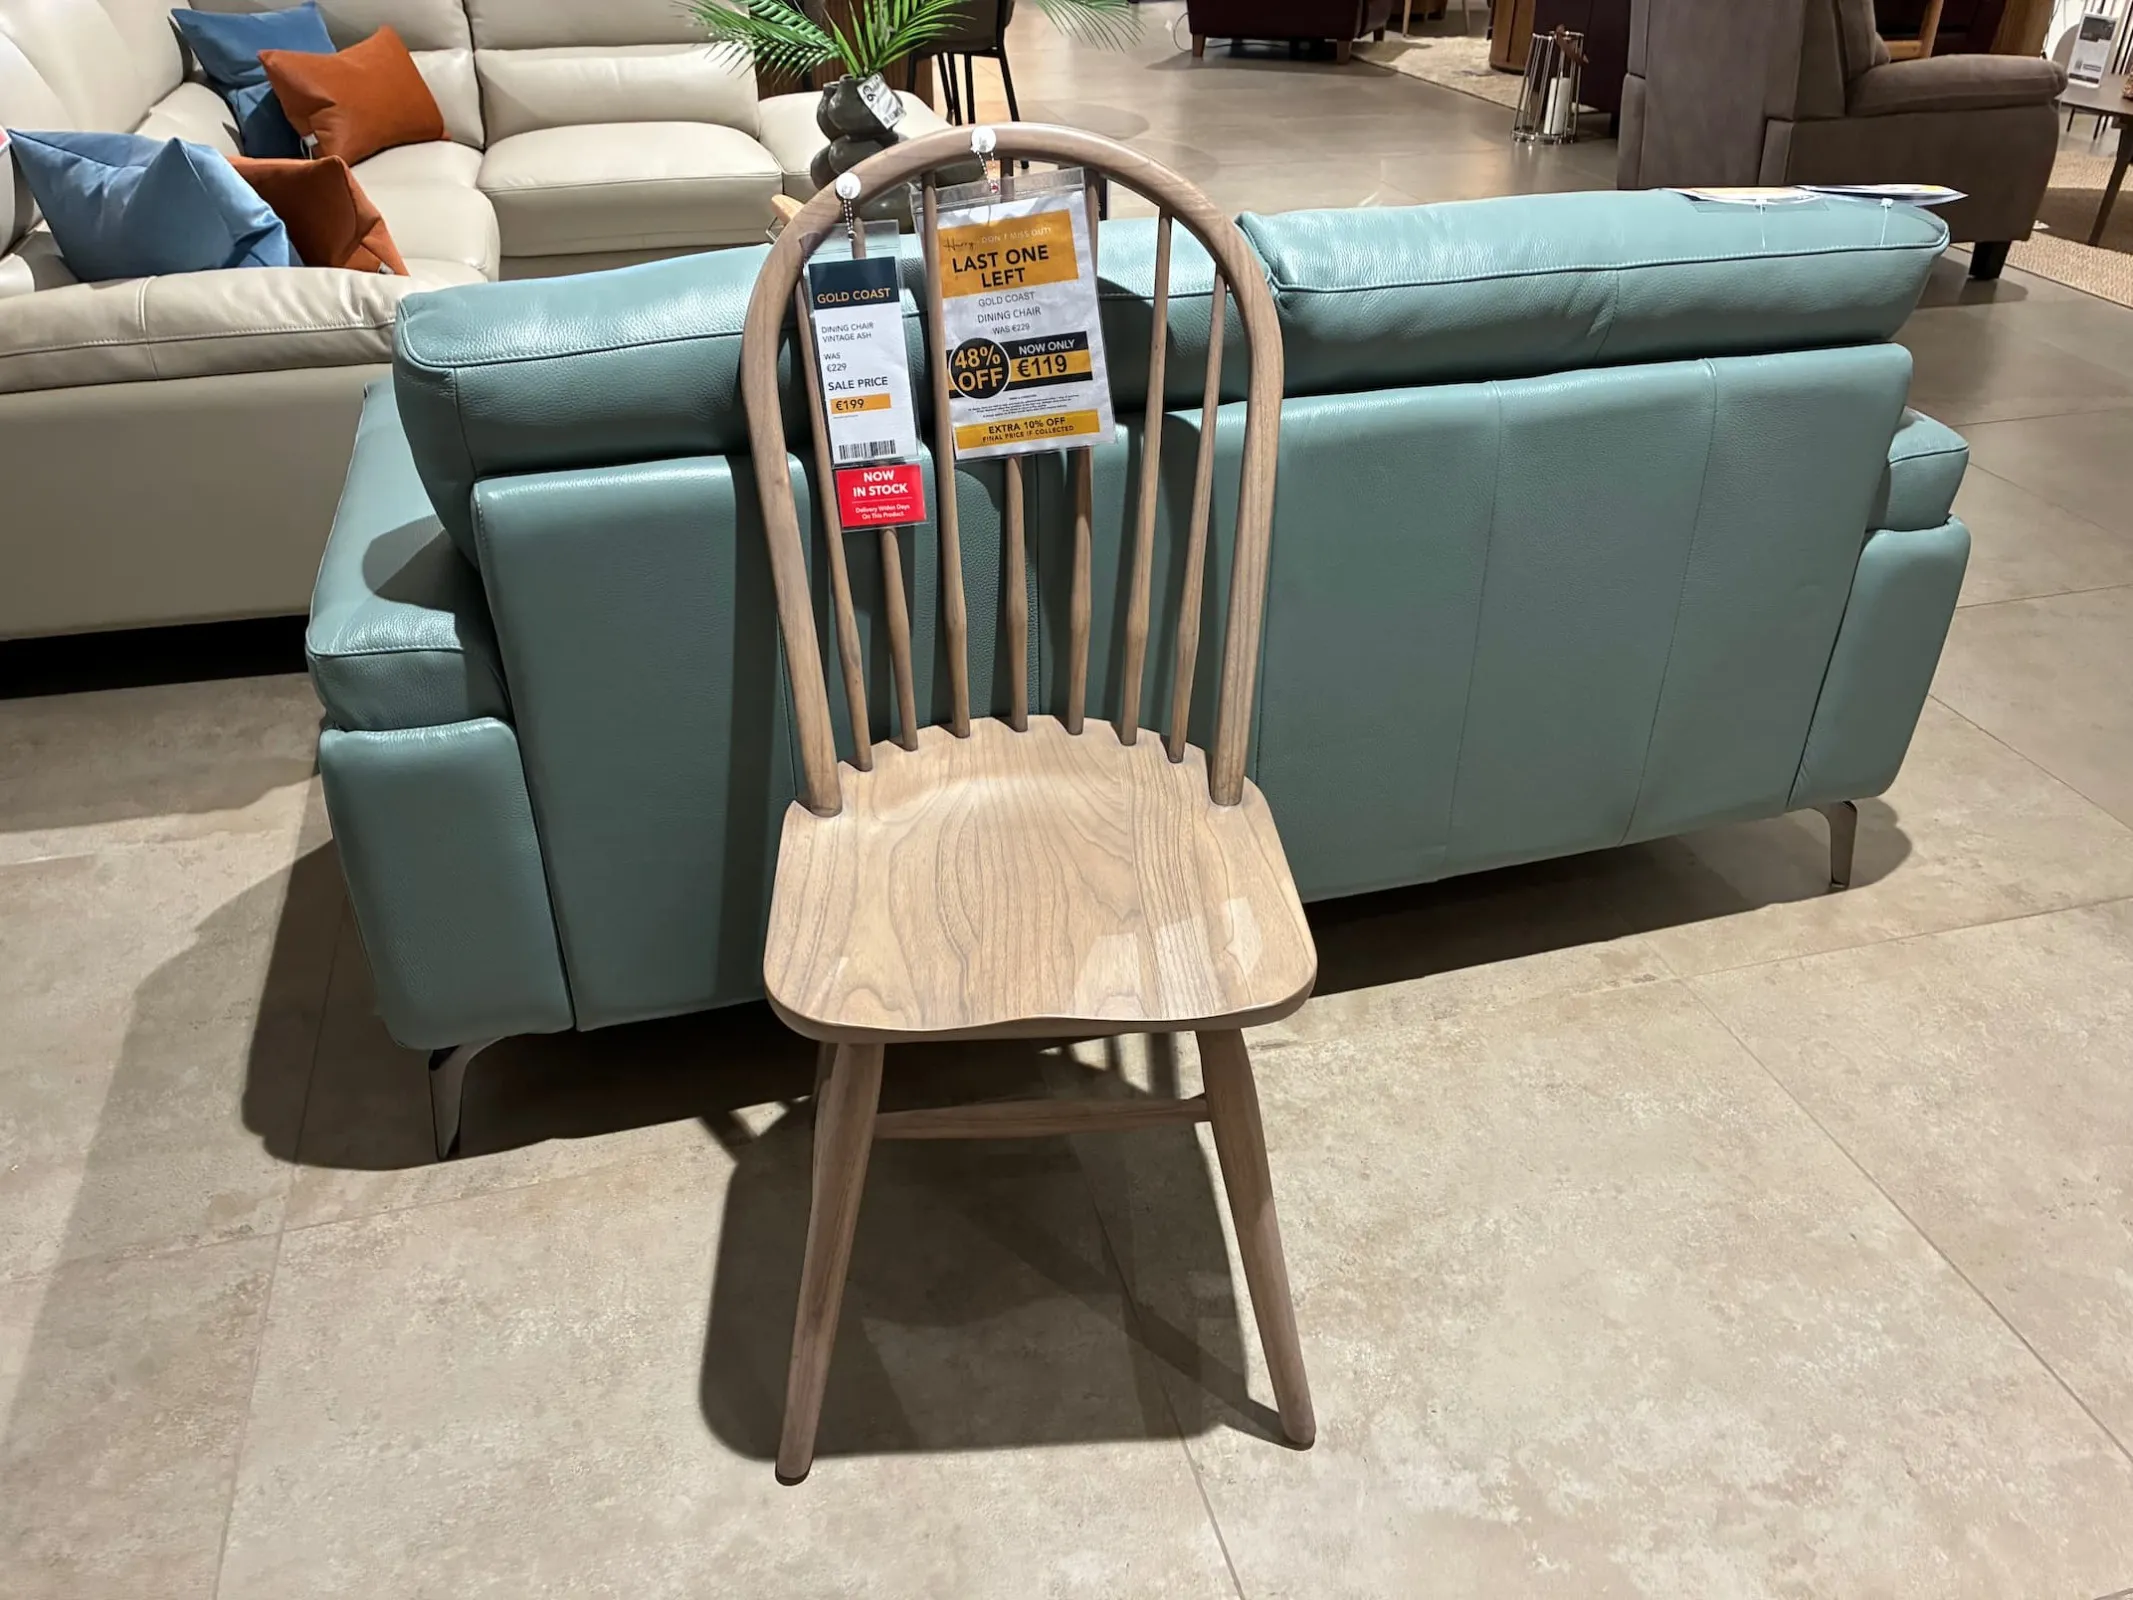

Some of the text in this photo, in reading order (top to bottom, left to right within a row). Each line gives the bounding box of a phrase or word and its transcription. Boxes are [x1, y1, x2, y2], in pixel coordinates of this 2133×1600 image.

[952, 244, 1049, 273] LAST ONE
[981, 267, 1025, 288] LEFT
[817, 287, 891, 304] GOLD COAST
[978, 291, 1035, 308] GOLD COAST
[977, 306, 1041, 324] DINING CHAIR
[821, 321, 874, 334] DINING CHAIR
[992, 322, 1030, 335] WAS €229
[822, 332, 872, 343] VINTAGE ASH
[1018, 339, 1075, 355] NOW ONLY
[824, 352, 841, 361] WAS
[955, 345, 1000, 369] 48%
[826, 362, 848, 373] €229
[1017, 354, 1067, 378] €119
[828, 376, 889, 391] SALE PRICE
[958, 366, 1003, 392] OFF
[835, 398, 865, 411] €199
[988, 416, 1066, 434] EXTRA 10% OFF
[1004, 432, 1025, 440] PRICE
[1035, 425, 1075, 436] COLLECTED
[863, 470, 894, 482] NOW
[852, 482, 909, 497] IN STOCK
